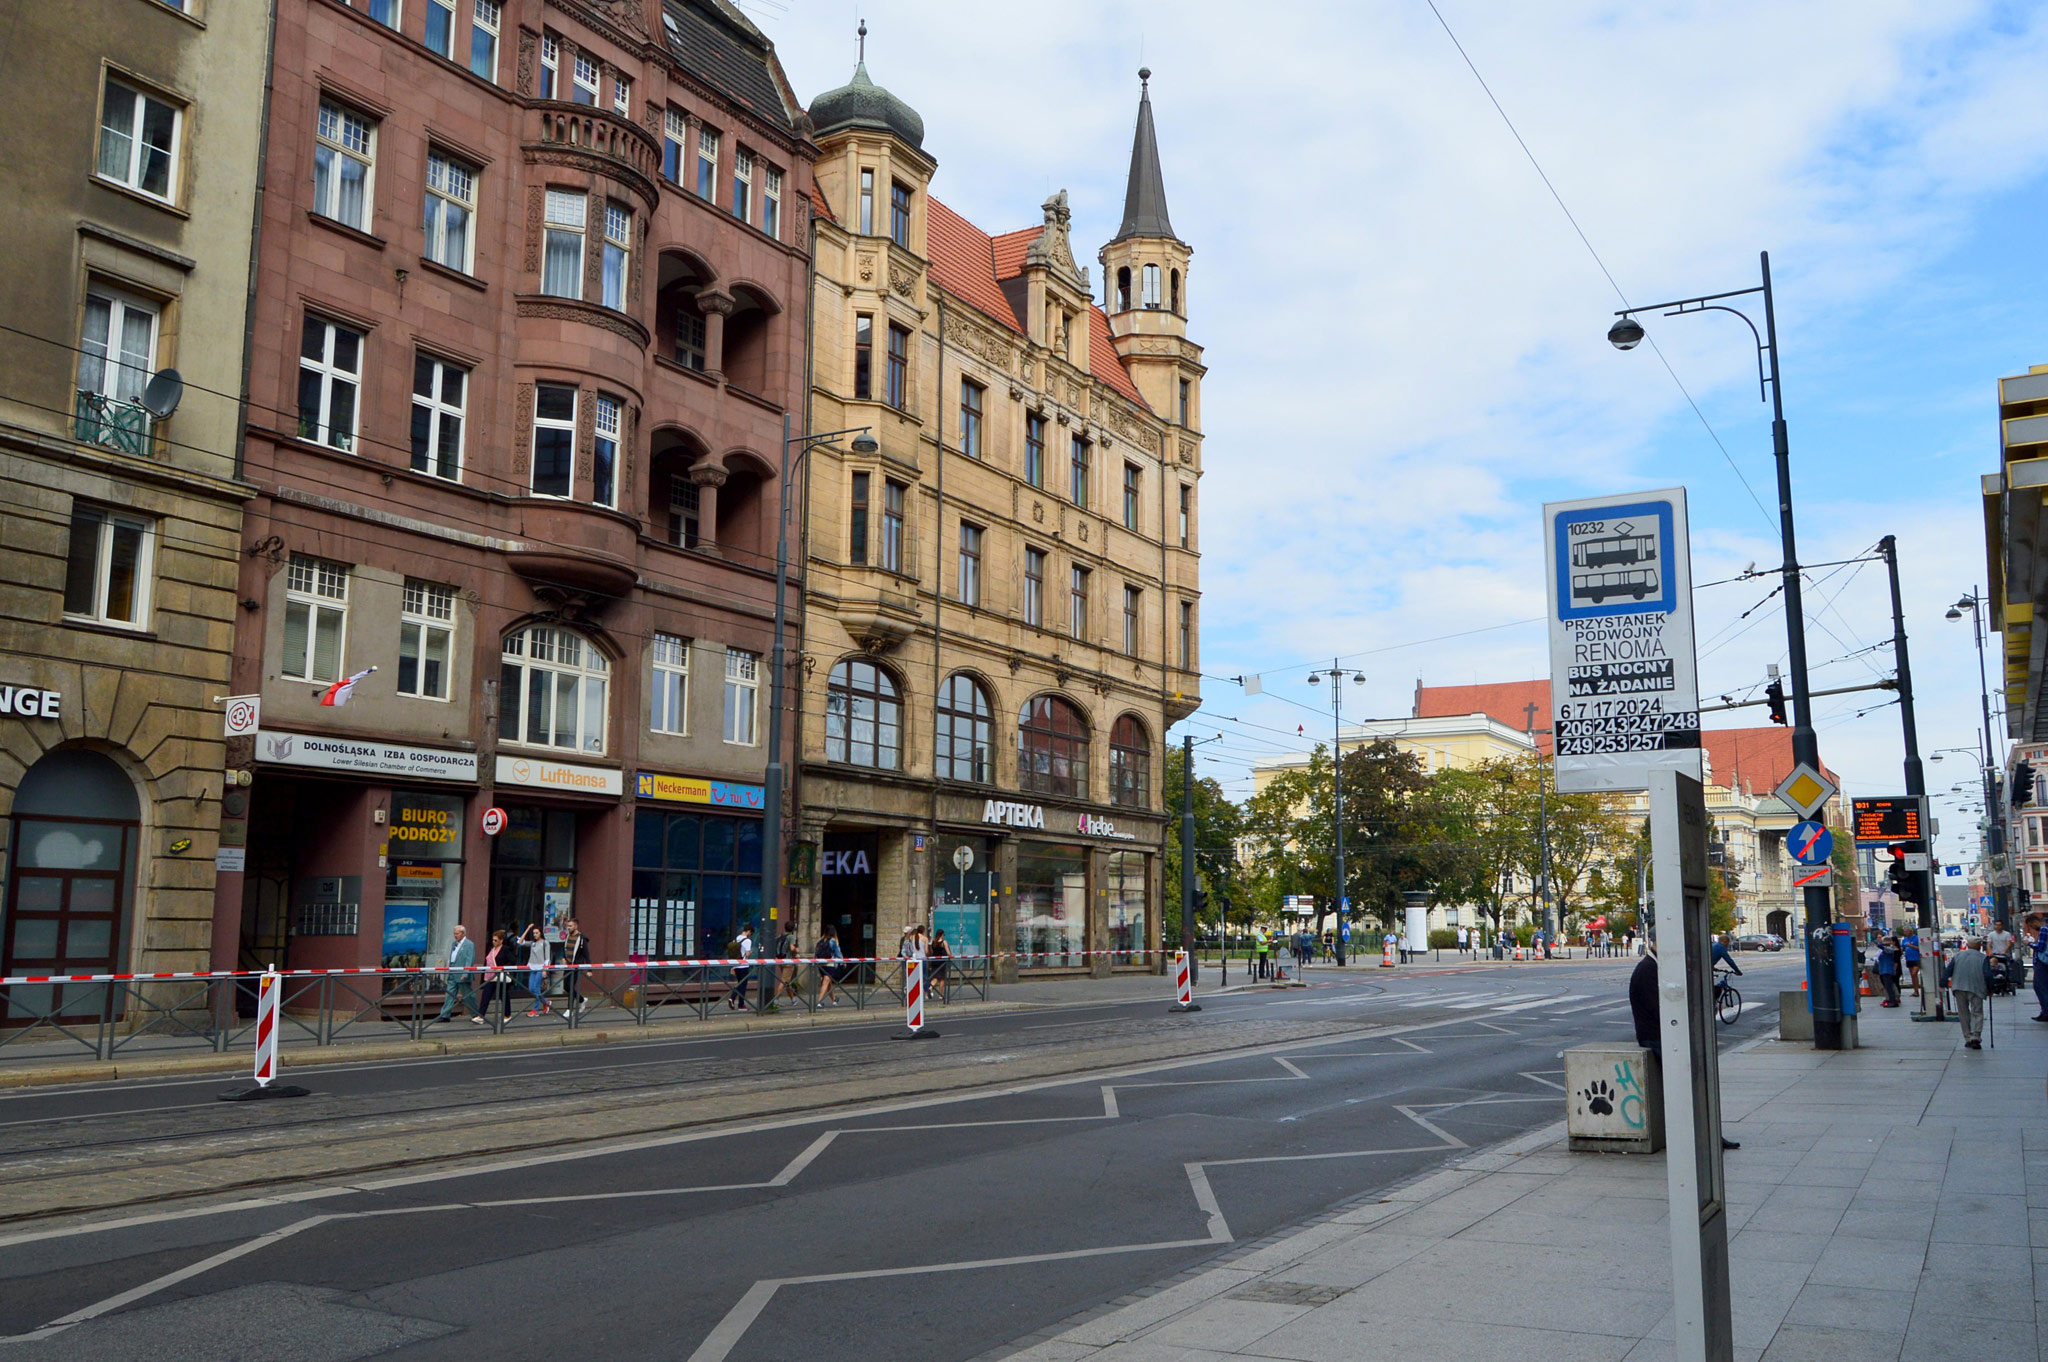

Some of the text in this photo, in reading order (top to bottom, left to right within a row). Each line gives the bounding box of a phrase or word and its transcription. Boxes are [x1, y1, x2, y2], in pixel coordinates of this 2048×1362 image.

[1568, 522, 1604, 535] 10232
[1565, 613, 1666, 631] PRZYSTANEK
[1576, 626, 1663, 642] PODWÓJNY
[1575, 638, 1666, 662] RENOMA
[1569, 660, 1669, 679] BUS NOCNY
[1570, 677, 1673, 695] NA ŻĄDANIE
[1561, 698, 1661, 719] 6 7 17 20 24
[1561, 712, 1698, 737] 206 243 247 248
[1560, 733, 1663, 755] 249 253 257
[303, 741, 475, 768] DOLNOŚLĄSKA IZBA GOSPODARCZA
[333, 757, 446, 775] Lower Silesian Chamber of Commerce
[540, 766, 606, 788] Lufthansa
[657, 781, 707, 797] Neckermann
[730, 793, 742, 803] TUI
[402, 808, 447, 824] BIURO
[982, 799, 1114, 836] APTEKA hebe
[388, 824, 457, 842] PODRÓŻY
